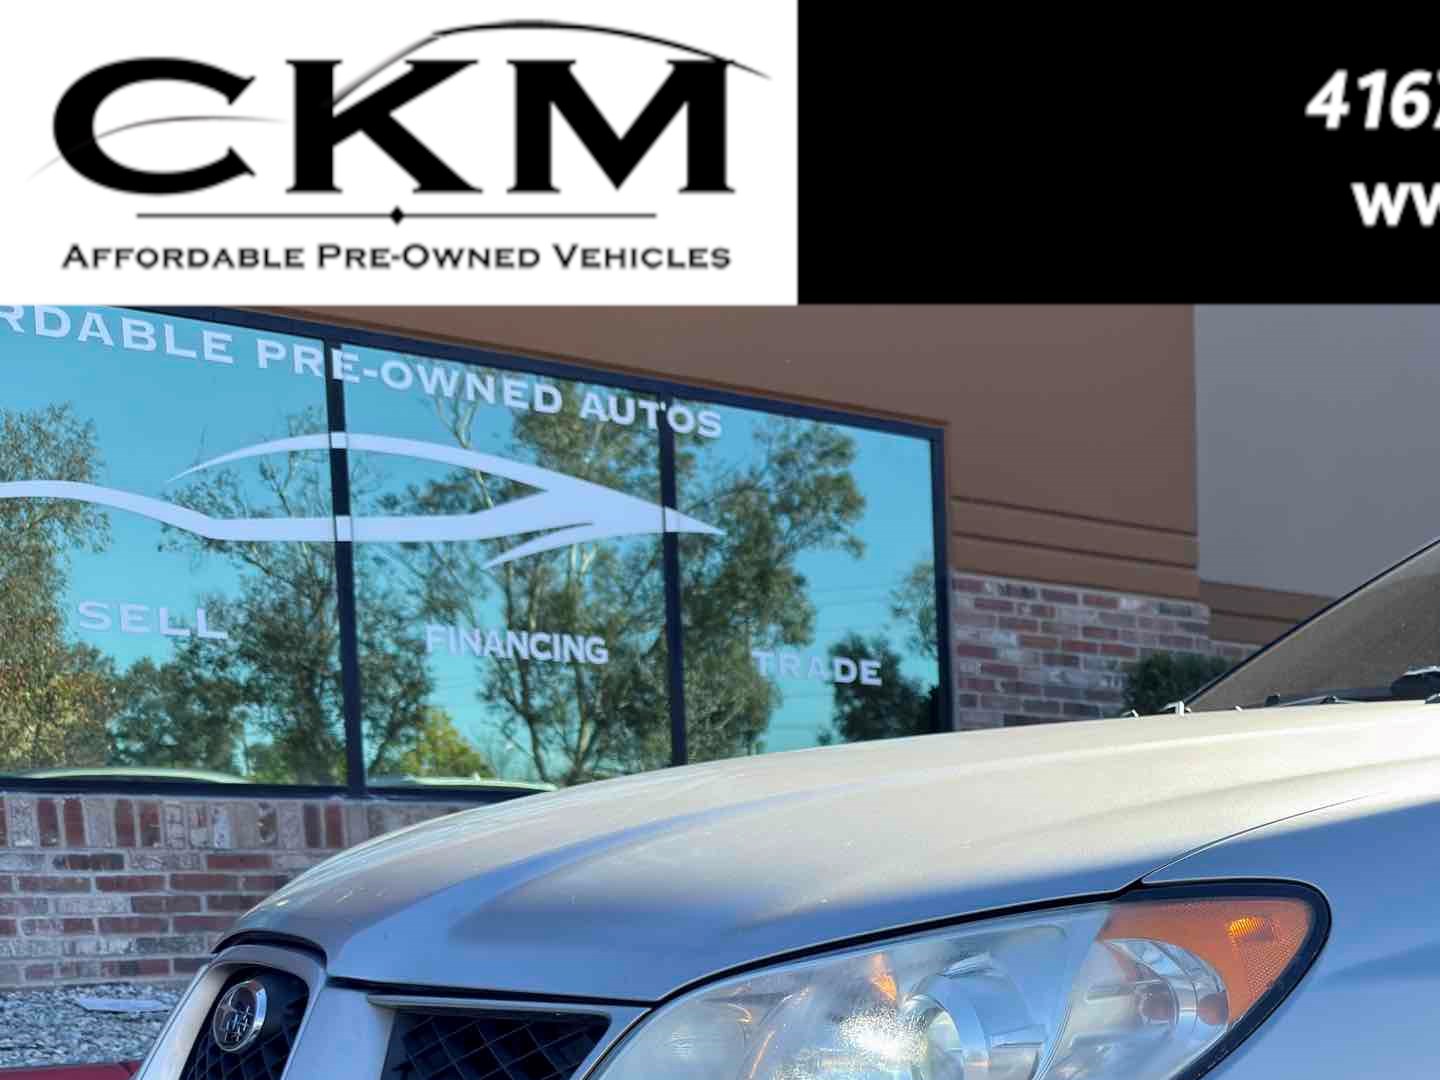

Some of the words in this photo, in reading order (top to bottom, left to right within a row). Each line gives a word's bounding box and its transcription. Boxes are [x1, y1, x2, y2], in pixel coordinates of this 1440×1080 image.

[256, 338, 563, 415] PRE-OWNED
[579, 393, 722, 439] AUTOS
[78, 600, 229, 639] SELL
[424, 624, 609, 665] FINANCING
[750, 650, 882, 687] TRADE
